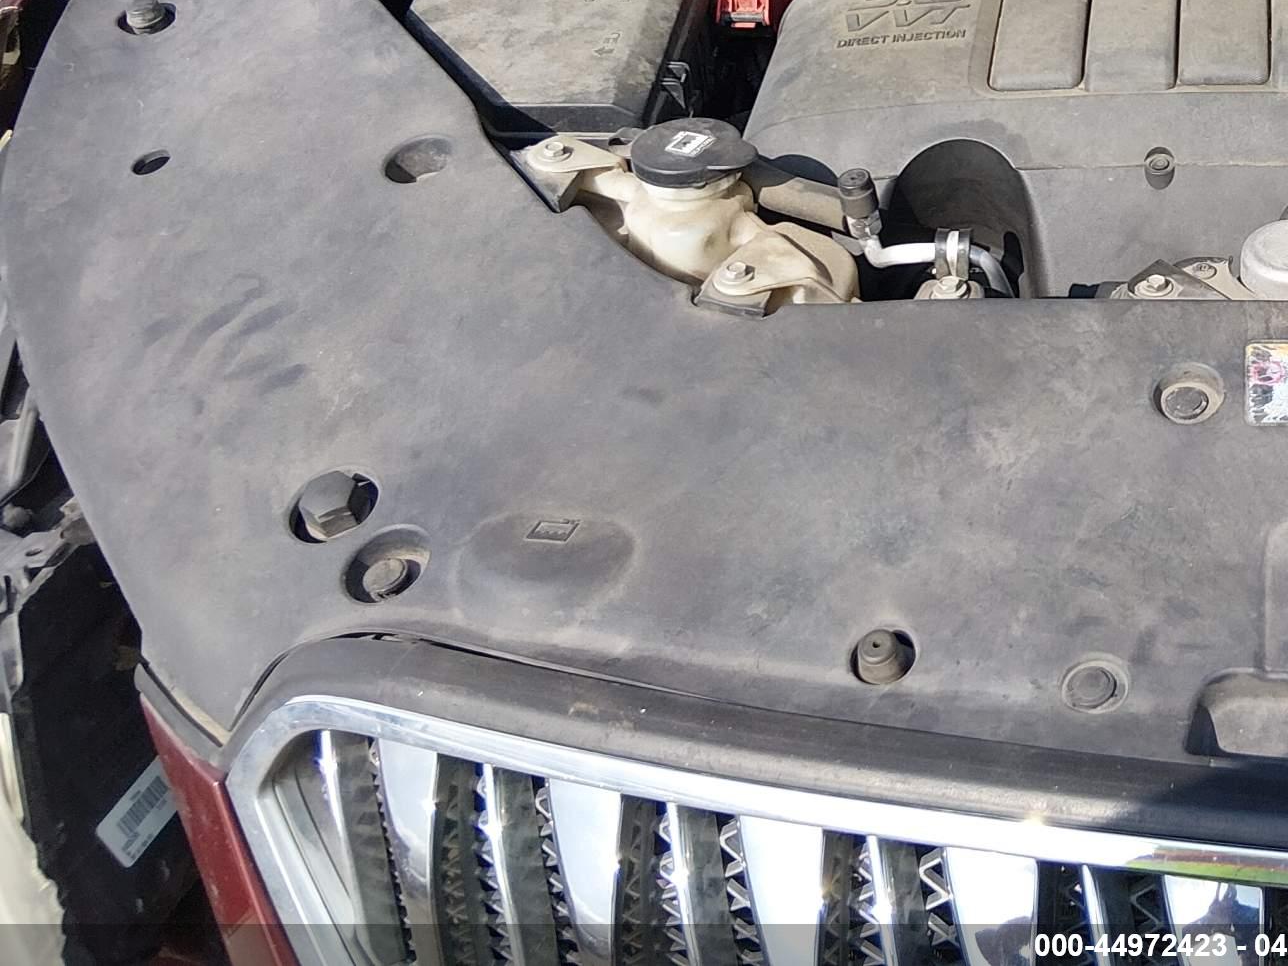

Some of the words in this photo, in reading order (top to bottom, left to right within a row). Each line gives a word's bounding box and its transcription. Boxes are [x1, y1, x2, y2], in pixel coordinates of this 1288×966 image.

[846, 3, 971, 33] VVT
[836, 34, 890, 49] DIRECT
[892, 29, 967, 43] INJECTION
